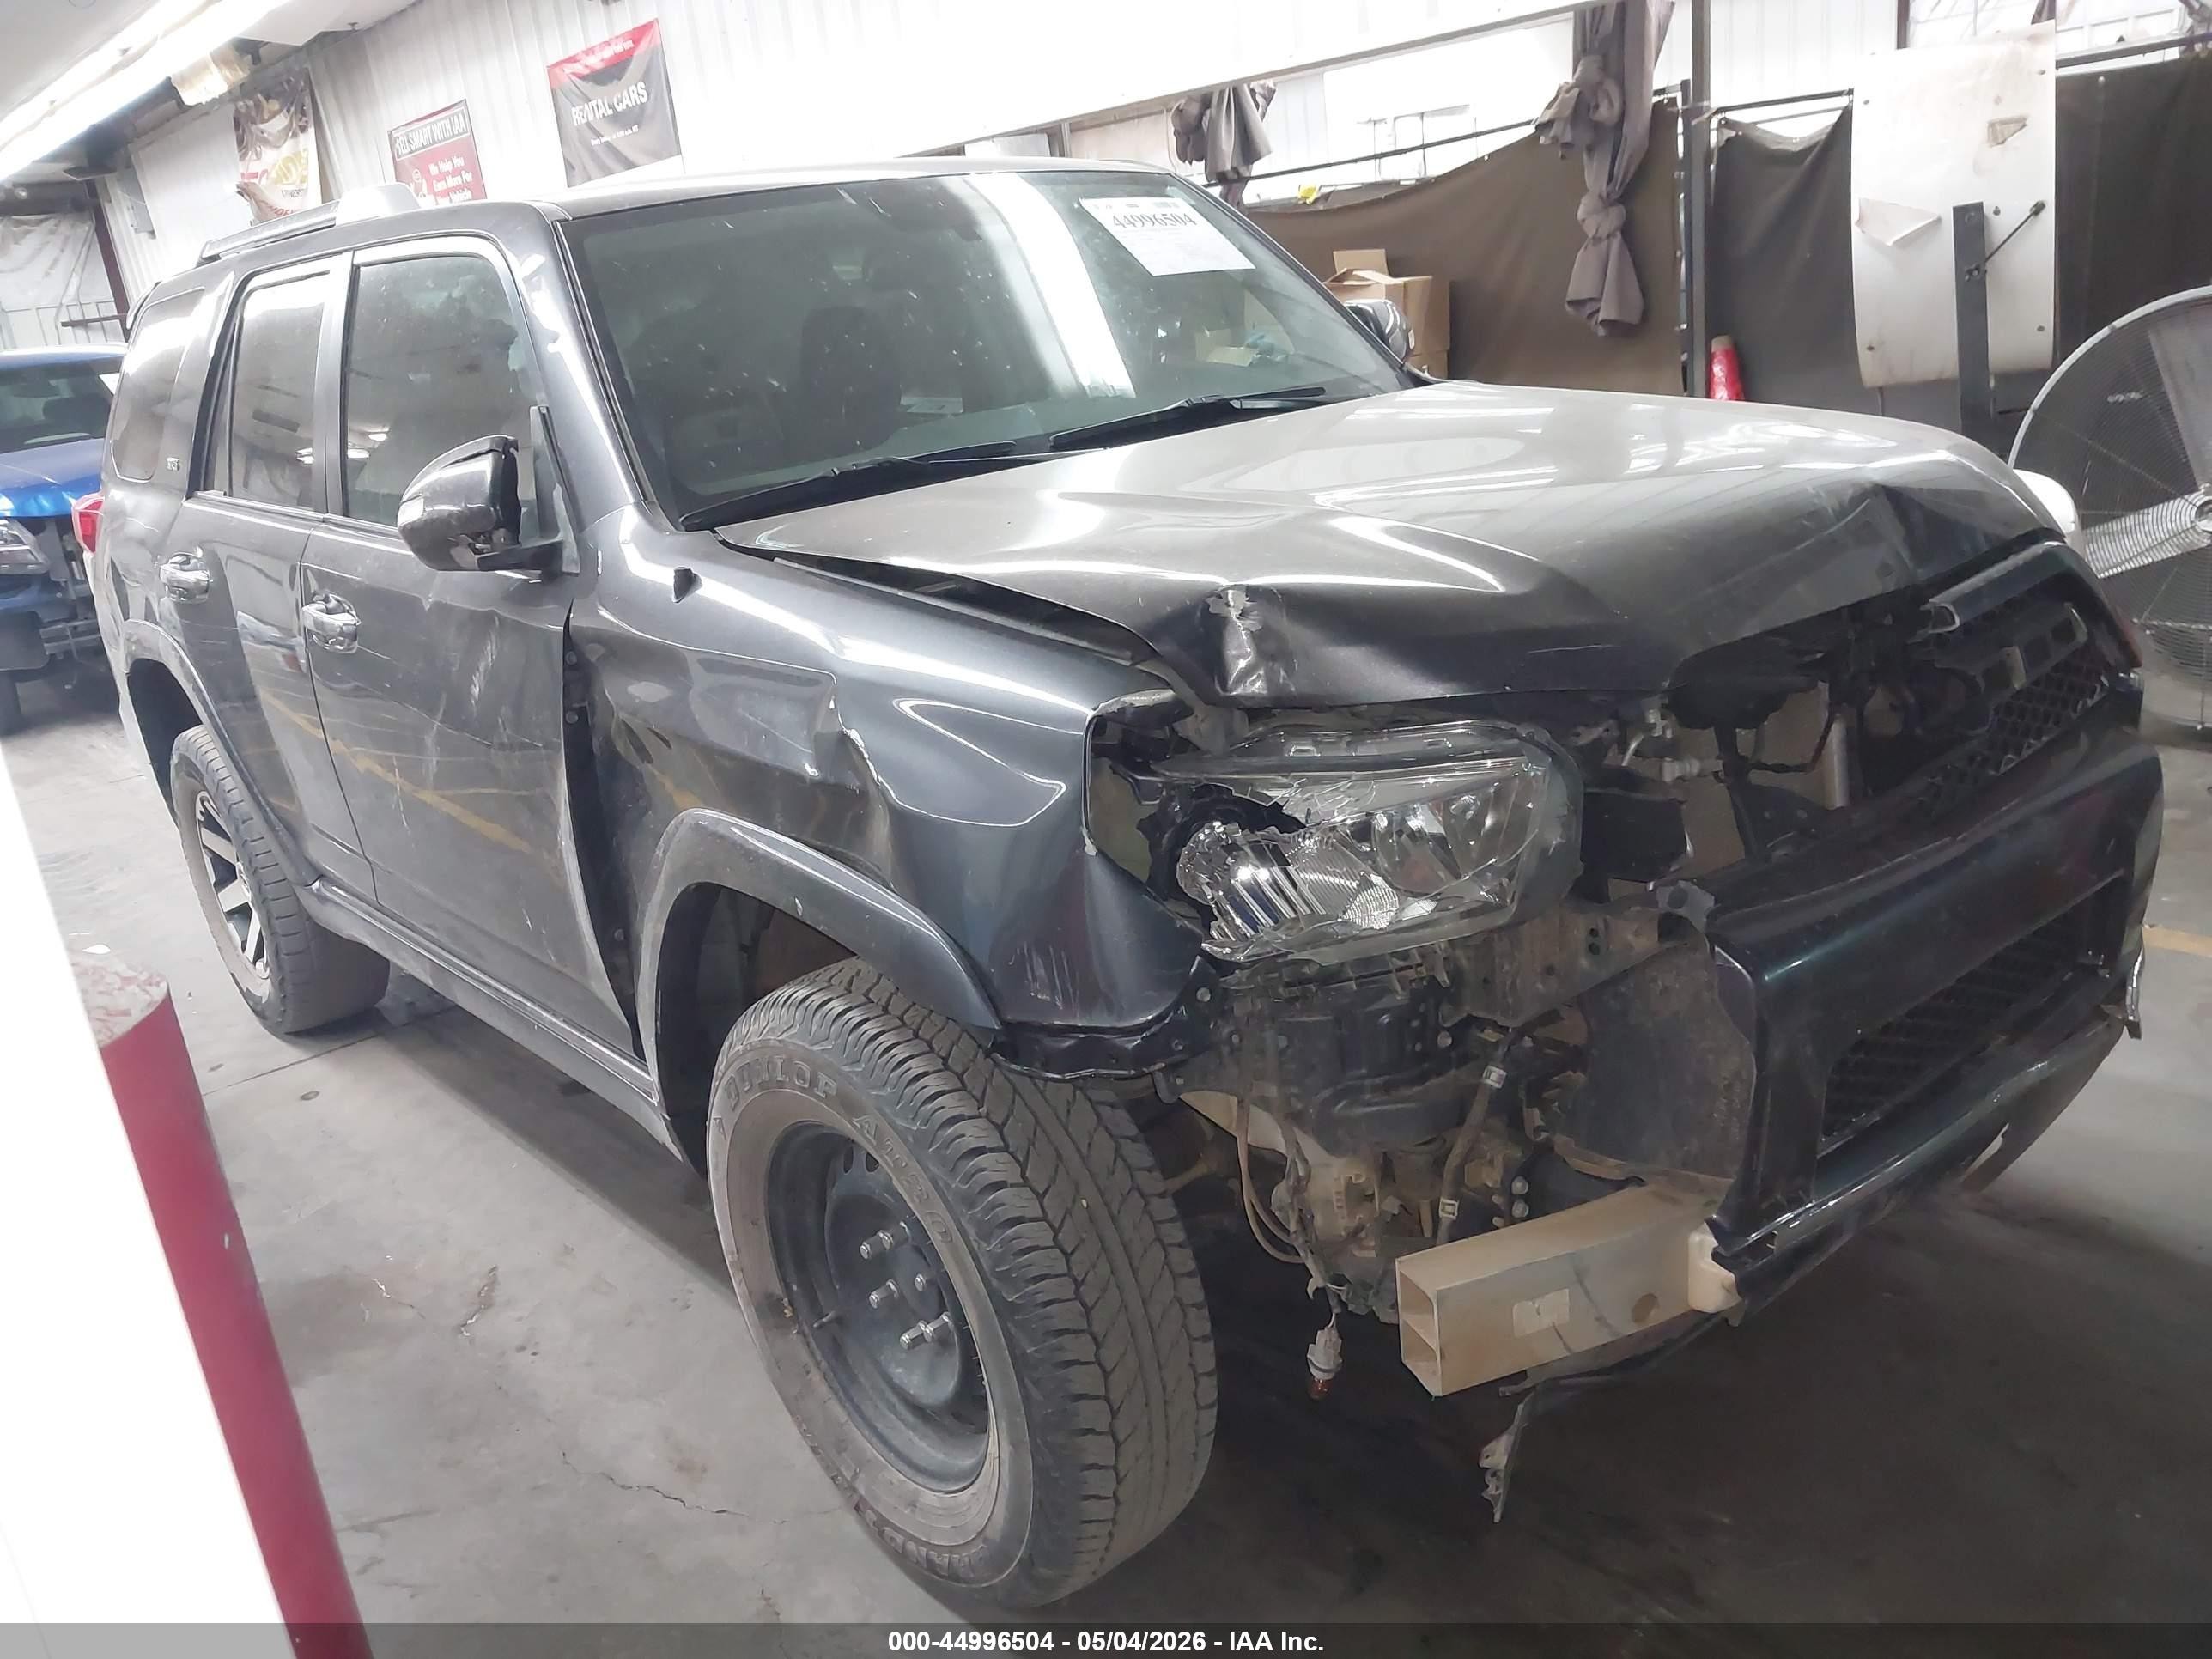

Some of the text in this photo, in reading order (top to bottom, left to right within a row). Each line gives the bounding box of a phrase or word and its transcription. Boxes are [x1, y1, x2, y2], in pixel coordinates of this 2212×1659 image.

[571, 82, 649, 126] RENTAL CARS
[432, 118, 453, 142] WITH
[1112, 212, 1198, 228] 44996504
[725, 1054, 838, 1112] DUNLOP
